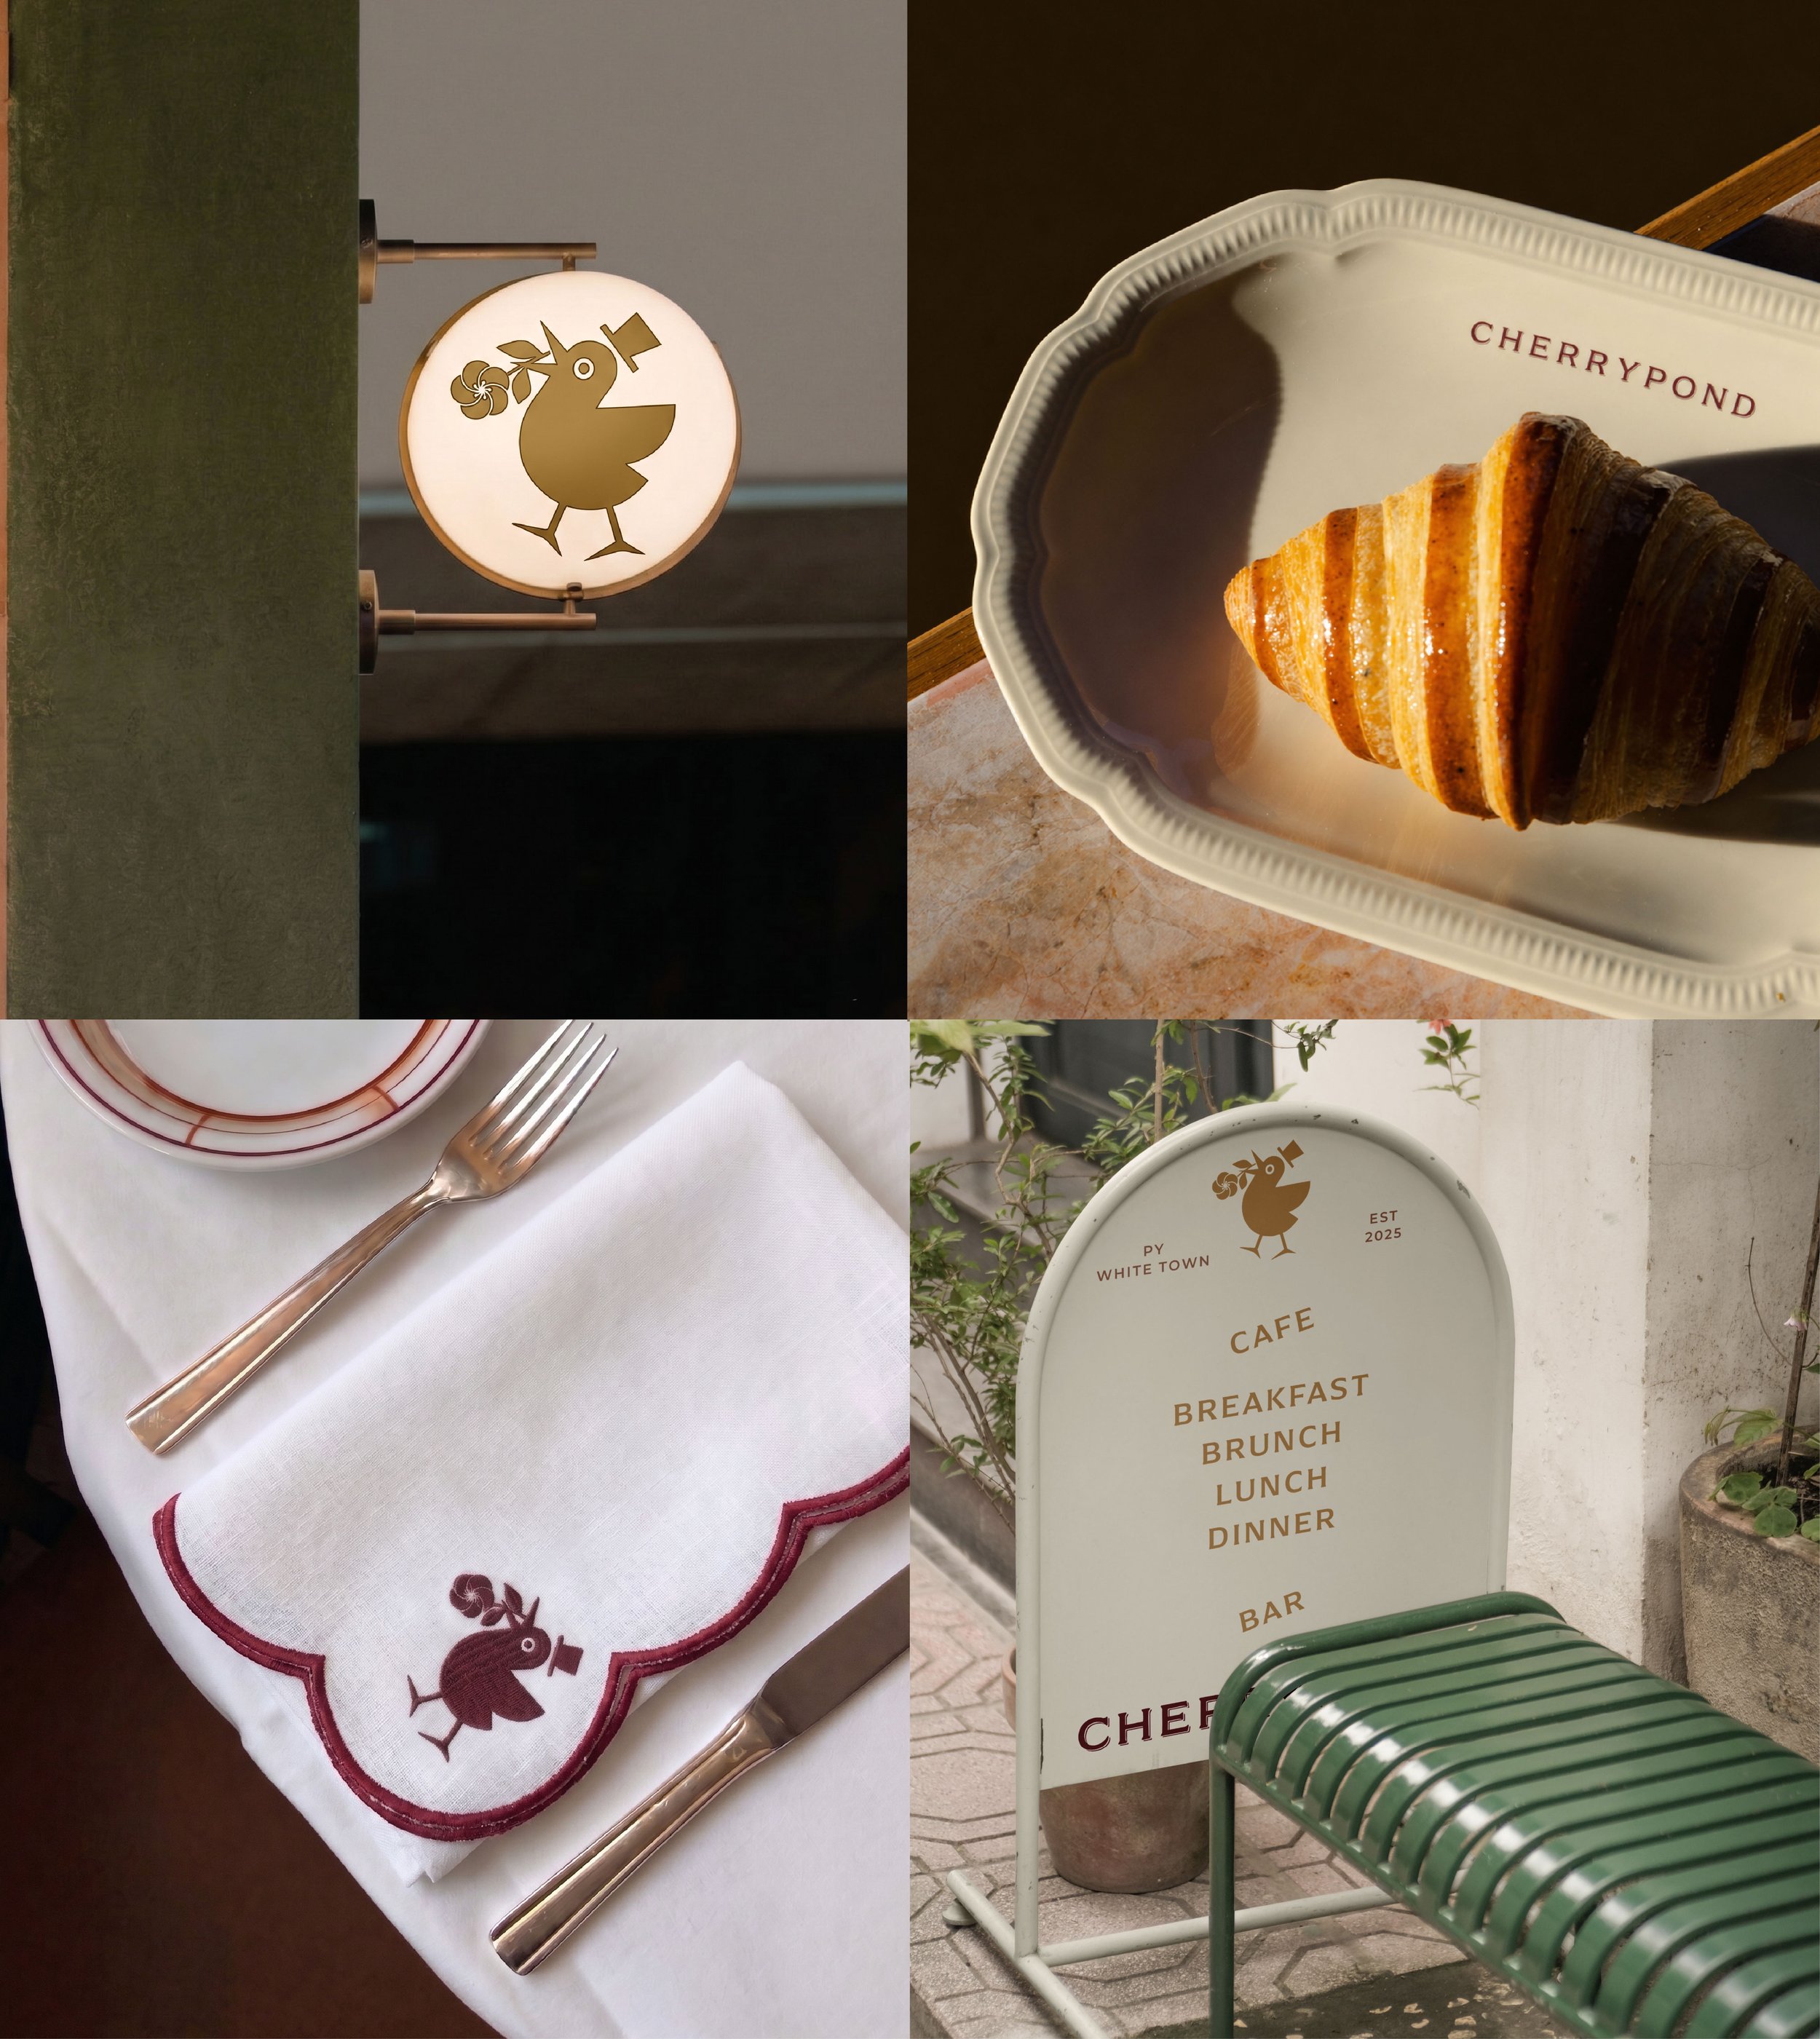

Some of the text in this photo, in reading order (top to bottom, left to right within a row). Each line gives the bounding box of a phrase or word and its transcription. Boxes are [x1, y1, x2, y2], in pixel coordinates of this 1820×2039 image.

[1470, 320, 1757, 419] CHERRYPOND
[1364, 1227, 1402, 1243] 2025
[1369, 1209, 1398, 1224] EST
[1096, 1254, 1210, 1282] WHITE TOWN
[1143, 1243, 1165, 1257] PY
[1230, 1307, 1315, 1354] CAFE
[1174, 1373, 1369, 1427] BREAKFAST
[1202, 1420, 1341, 1465] BRUNCH
[1216, 1465, 1327, 1506] LUNCH
[1208, 1508, 1336, 1550] DINNER
[1238, 1591, 1305, 1634] BAR
